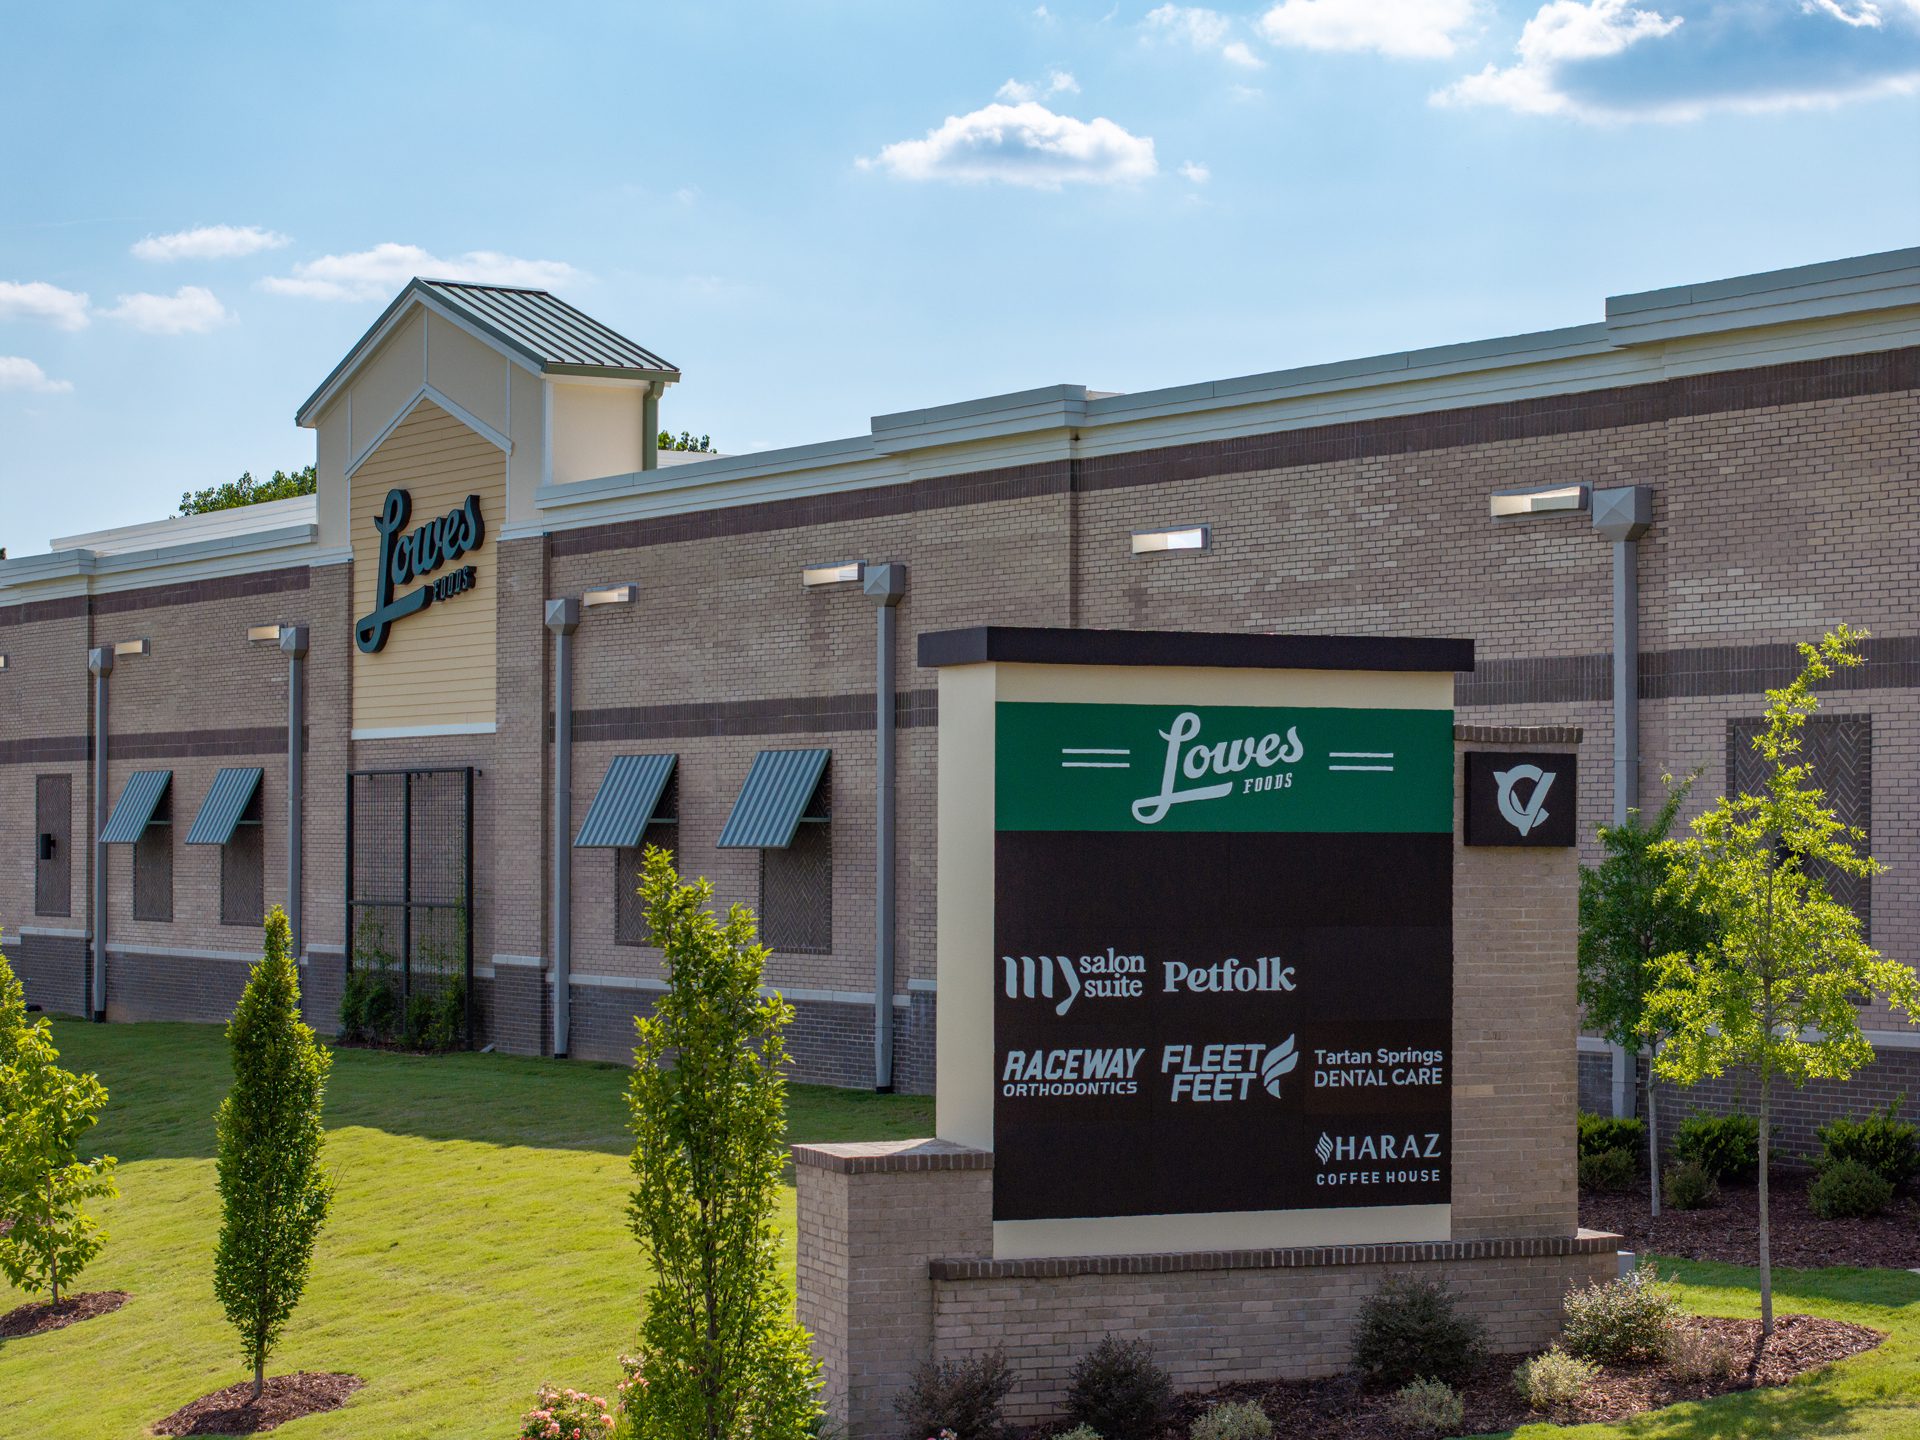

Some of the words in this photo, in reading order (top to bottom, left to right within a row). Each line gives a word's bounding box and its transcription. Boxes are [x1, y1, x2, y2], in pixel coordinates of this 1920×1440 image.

[356, 489, 486, 653] Lowes
[433, 566, 477, 602] FOODS
[1131, 712, 1304, 825] Lowes
[1243, 772, 1293, 796] FOODS
[1080, 947, 1147, 974] salon
[1162, 956, 1297, 993] Petfolk
[1002, 956, 1081, 1016] my
[1084, 974, 1143, 998] suite
[1002, 1047, 1146, 1081] RACEWAY
[1161, 1043, 1266, 1073] FLEET
[1314, 1049, 1372, 1065] Tartan
[1376, 1046, 1443, 1067] Springs
[1003, 1081, 1138, 1097] ORTHODONTICS
[1170, 1072, 1258, 1102] FEET
[1314, 1069, 1388, 1088] DENTAL
[1391, 1067, 1443, 1086] CARE
[1335, 1133, 1442, 1161] HARAZ
[1316, 1171, 1380, 1186] COFFEE
[1386, 1169, 1440, 1183] HOUSE
